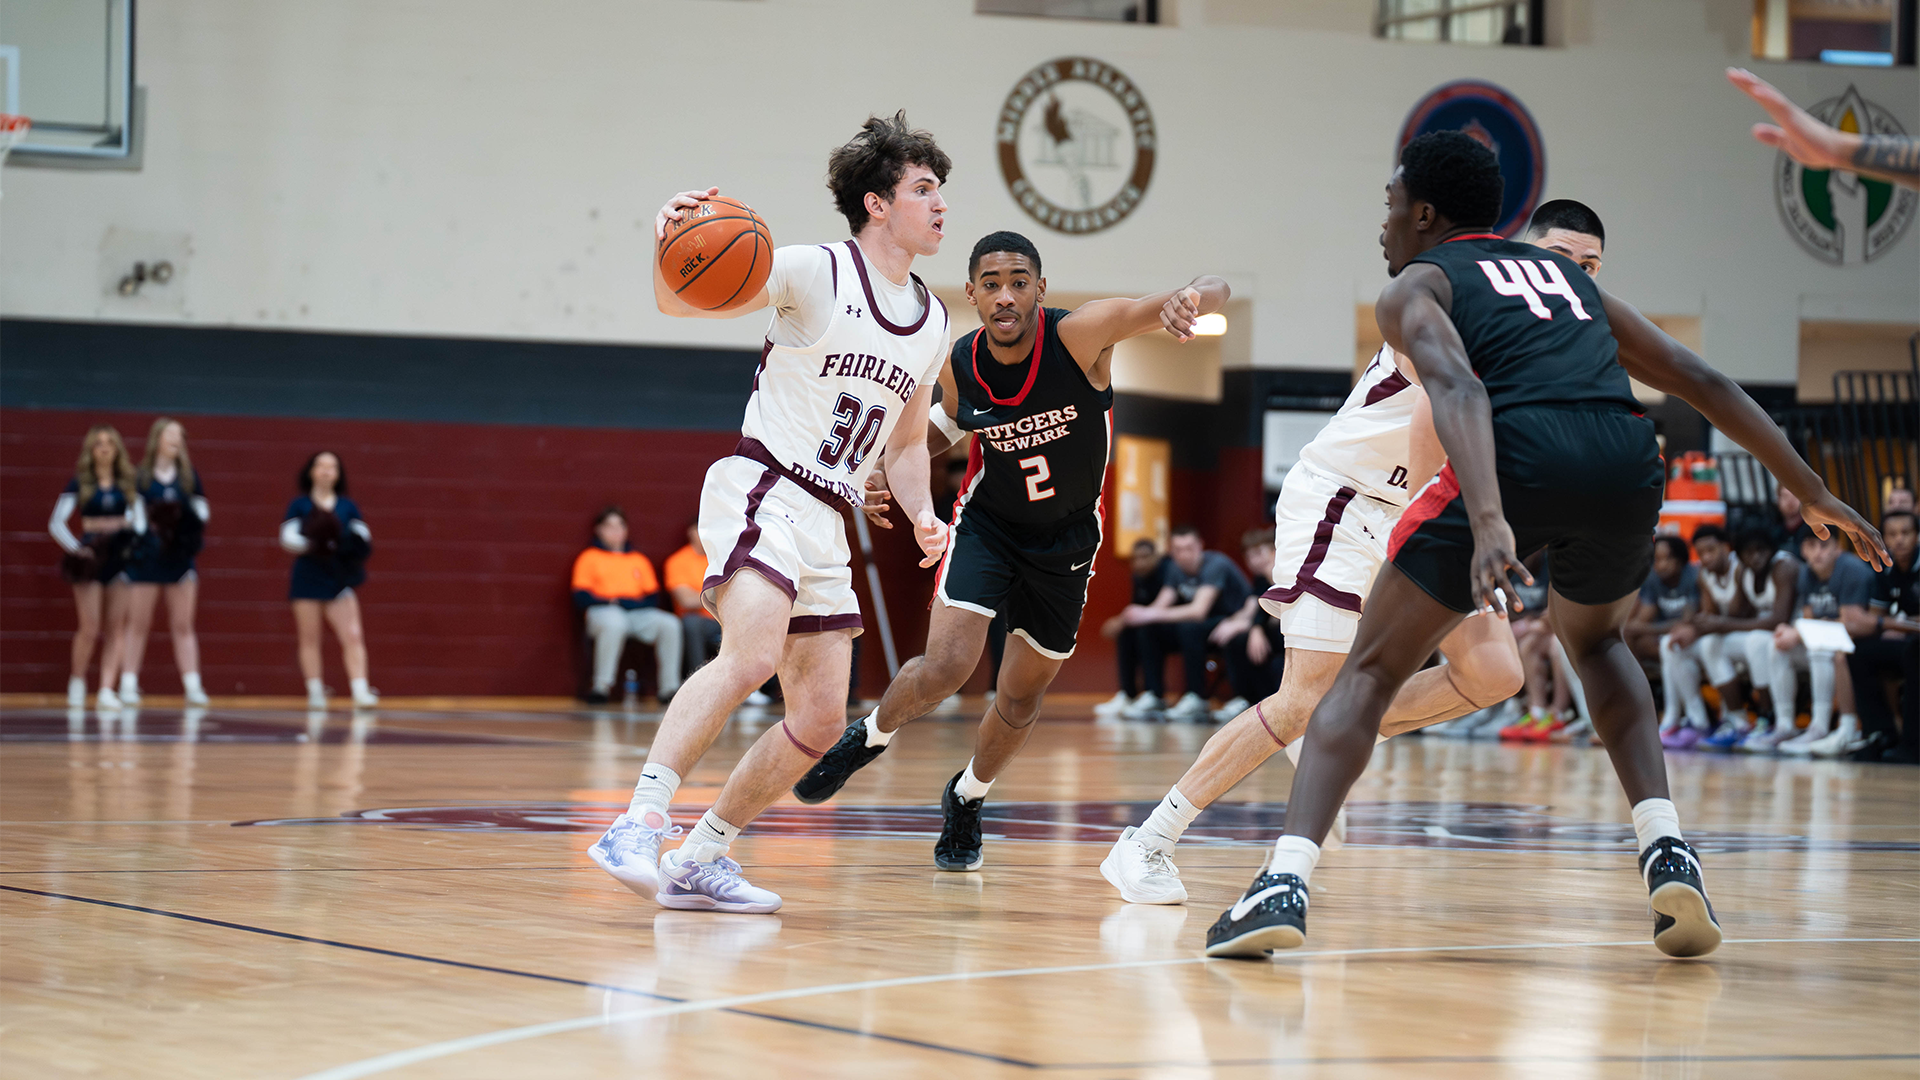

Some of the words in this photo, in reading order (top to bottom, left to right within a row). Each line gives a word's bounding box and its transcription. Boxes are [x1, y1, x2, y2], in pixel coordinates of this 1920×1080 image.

[679, 252, 706, 278] ROCK
[1475, 259, 1593, 321] 44
[819, 352, 917, 404] FAIRLEIG
[816, 391, 888, 475] 30
[990, 424, 1071, 453] NEWARK
[1018, 454, 1056, 502] 2
